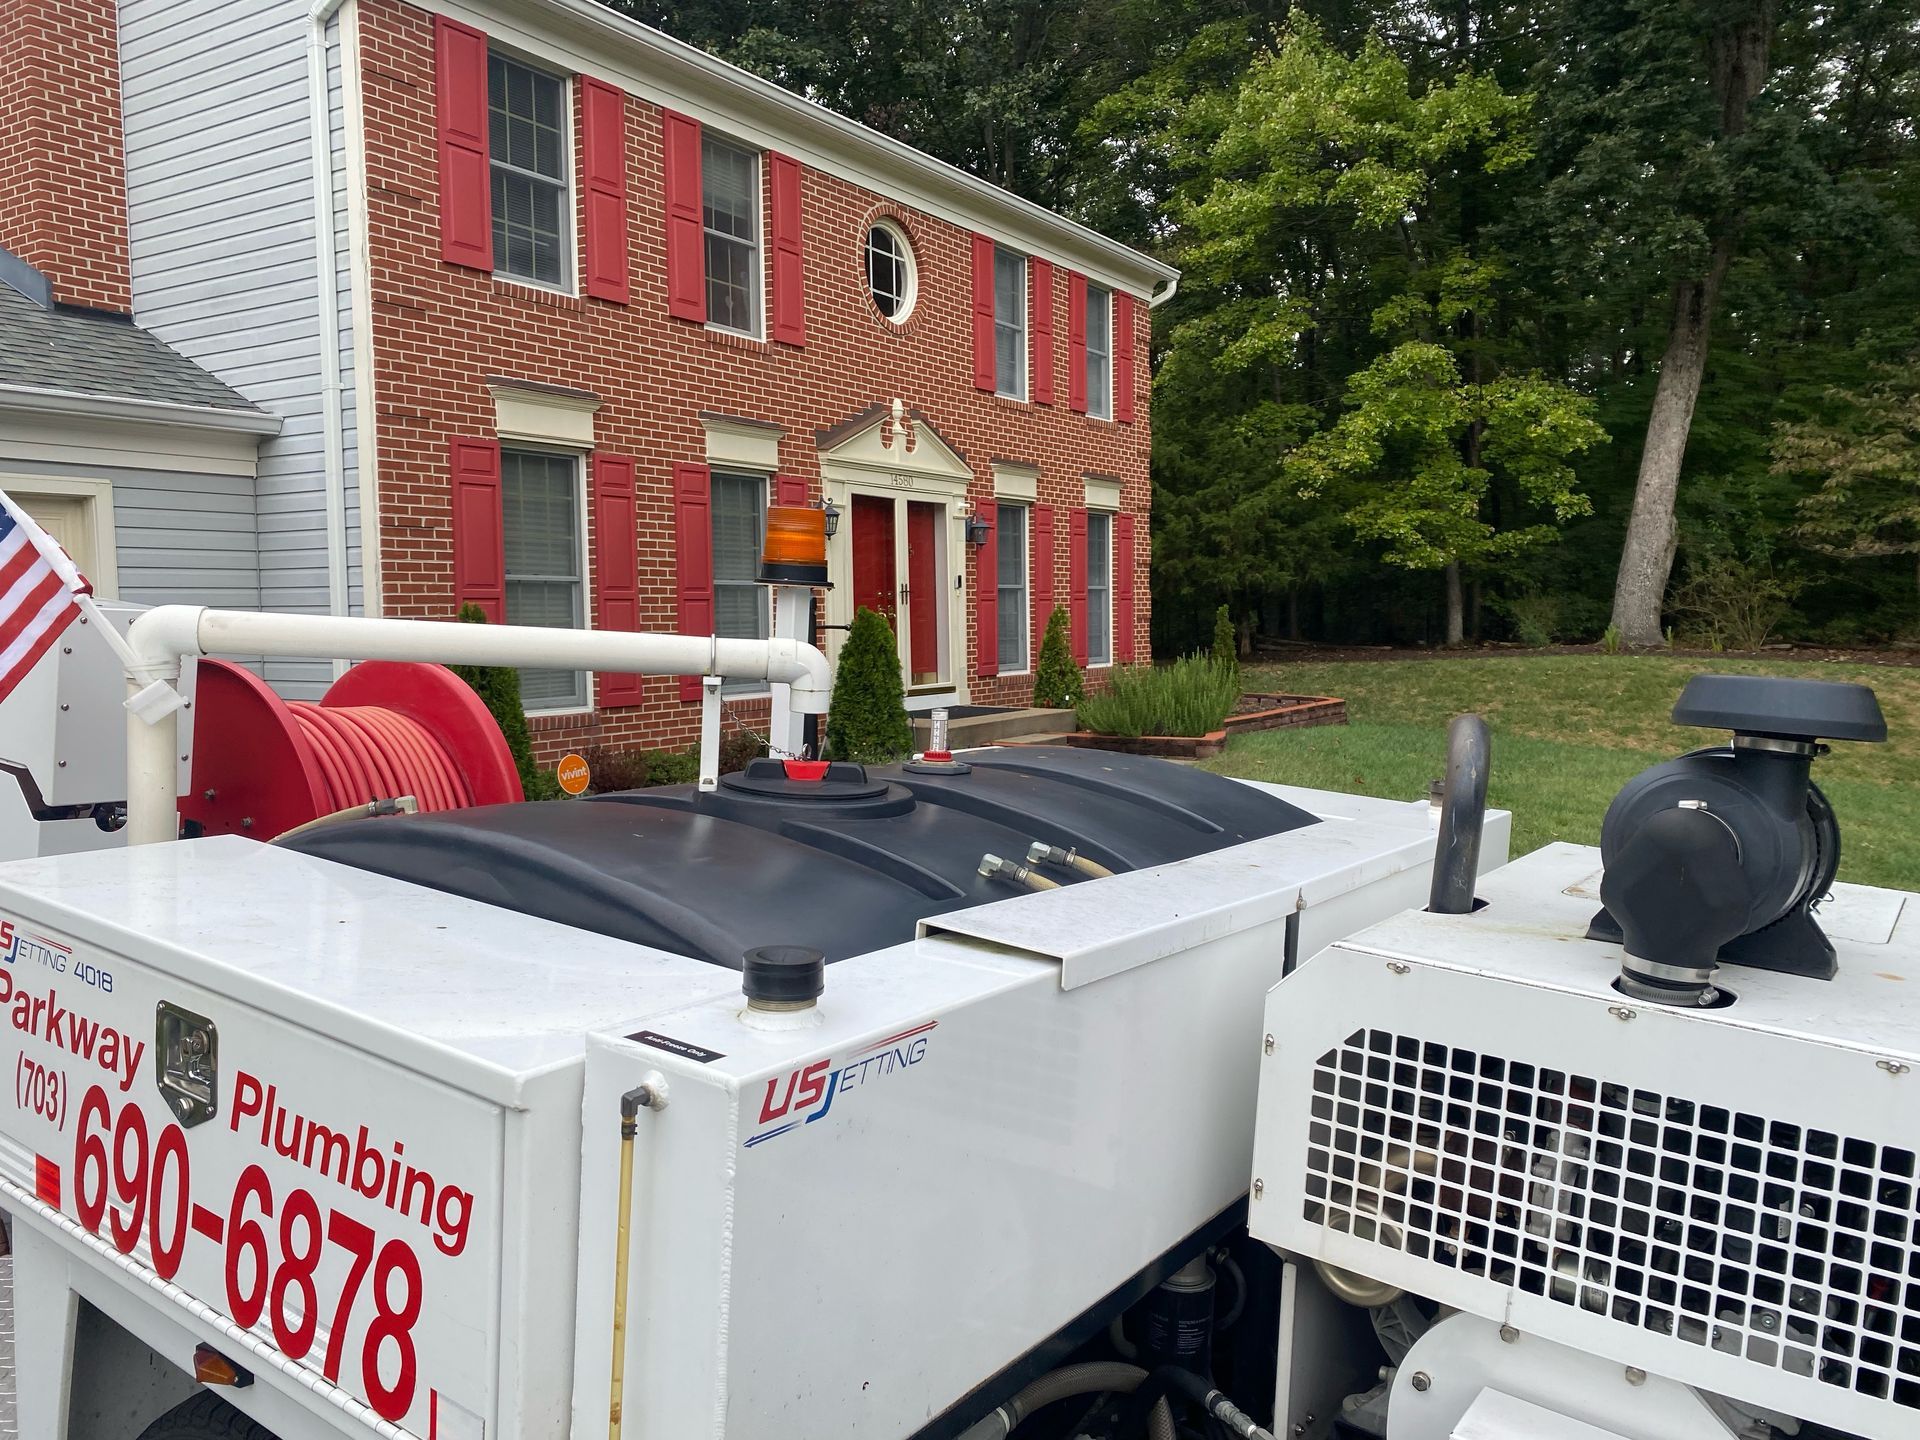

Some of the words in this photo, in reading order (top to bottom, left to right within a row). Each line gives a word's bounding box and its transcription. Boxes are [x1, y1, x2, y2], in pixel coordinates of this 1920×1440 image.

[561, 766, 588, 781] vivint
[73, 961, 113, 993] 4018
[230, 1070, 474, 1257] Plumbing
[16, 1050, 67, 1132] (703)
[74, 1085, 423, 1422] 690-6878
